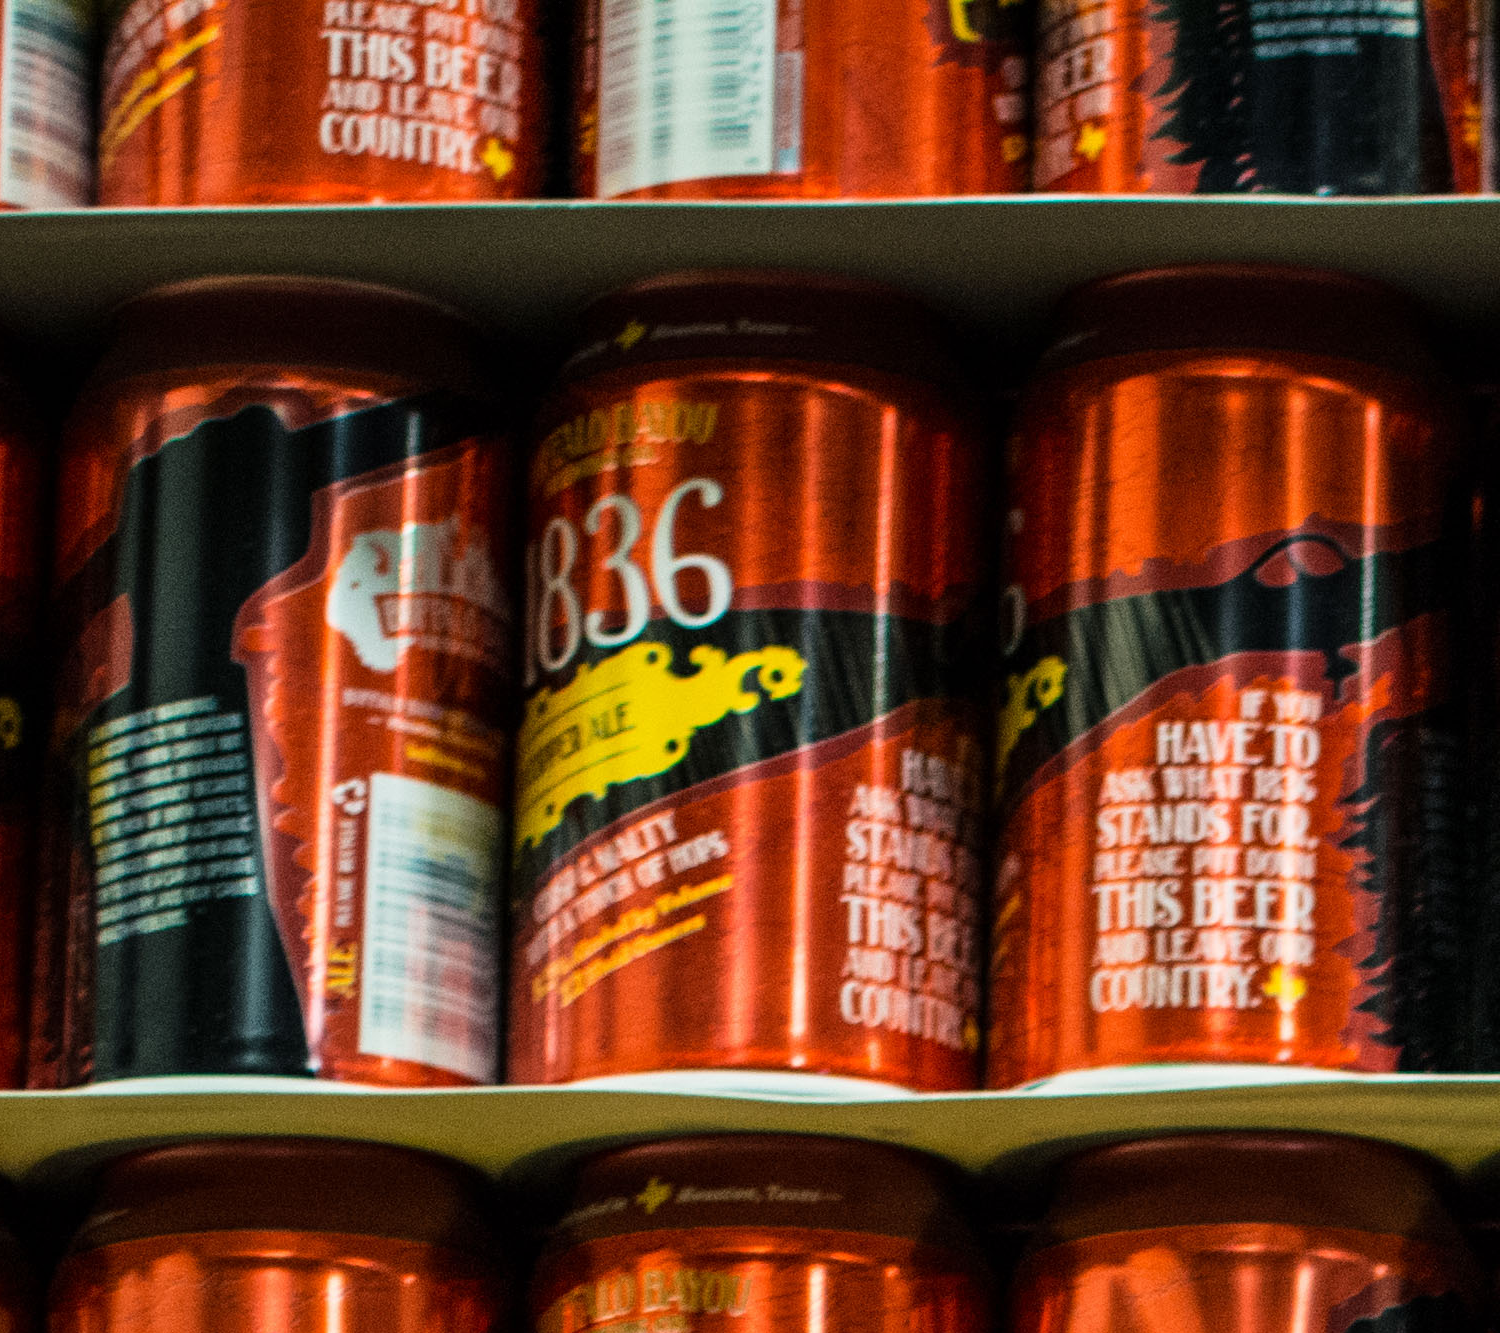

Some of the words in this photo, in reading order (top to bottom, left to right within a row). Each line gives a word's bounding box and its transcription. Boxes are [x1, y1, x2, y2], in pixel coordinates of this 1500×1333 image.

[322, 31, 414, 82] THIS
[522, 479, 733, 690] 1836
[1156, 723, 1262, 766] HAVE
[1269, 722, 1319, 763] TO
[1098, 808, 1227, 847] STANDS
[1092, 885, 1182, 928] THIS
[1194, 882, 1315, 928] BEER
